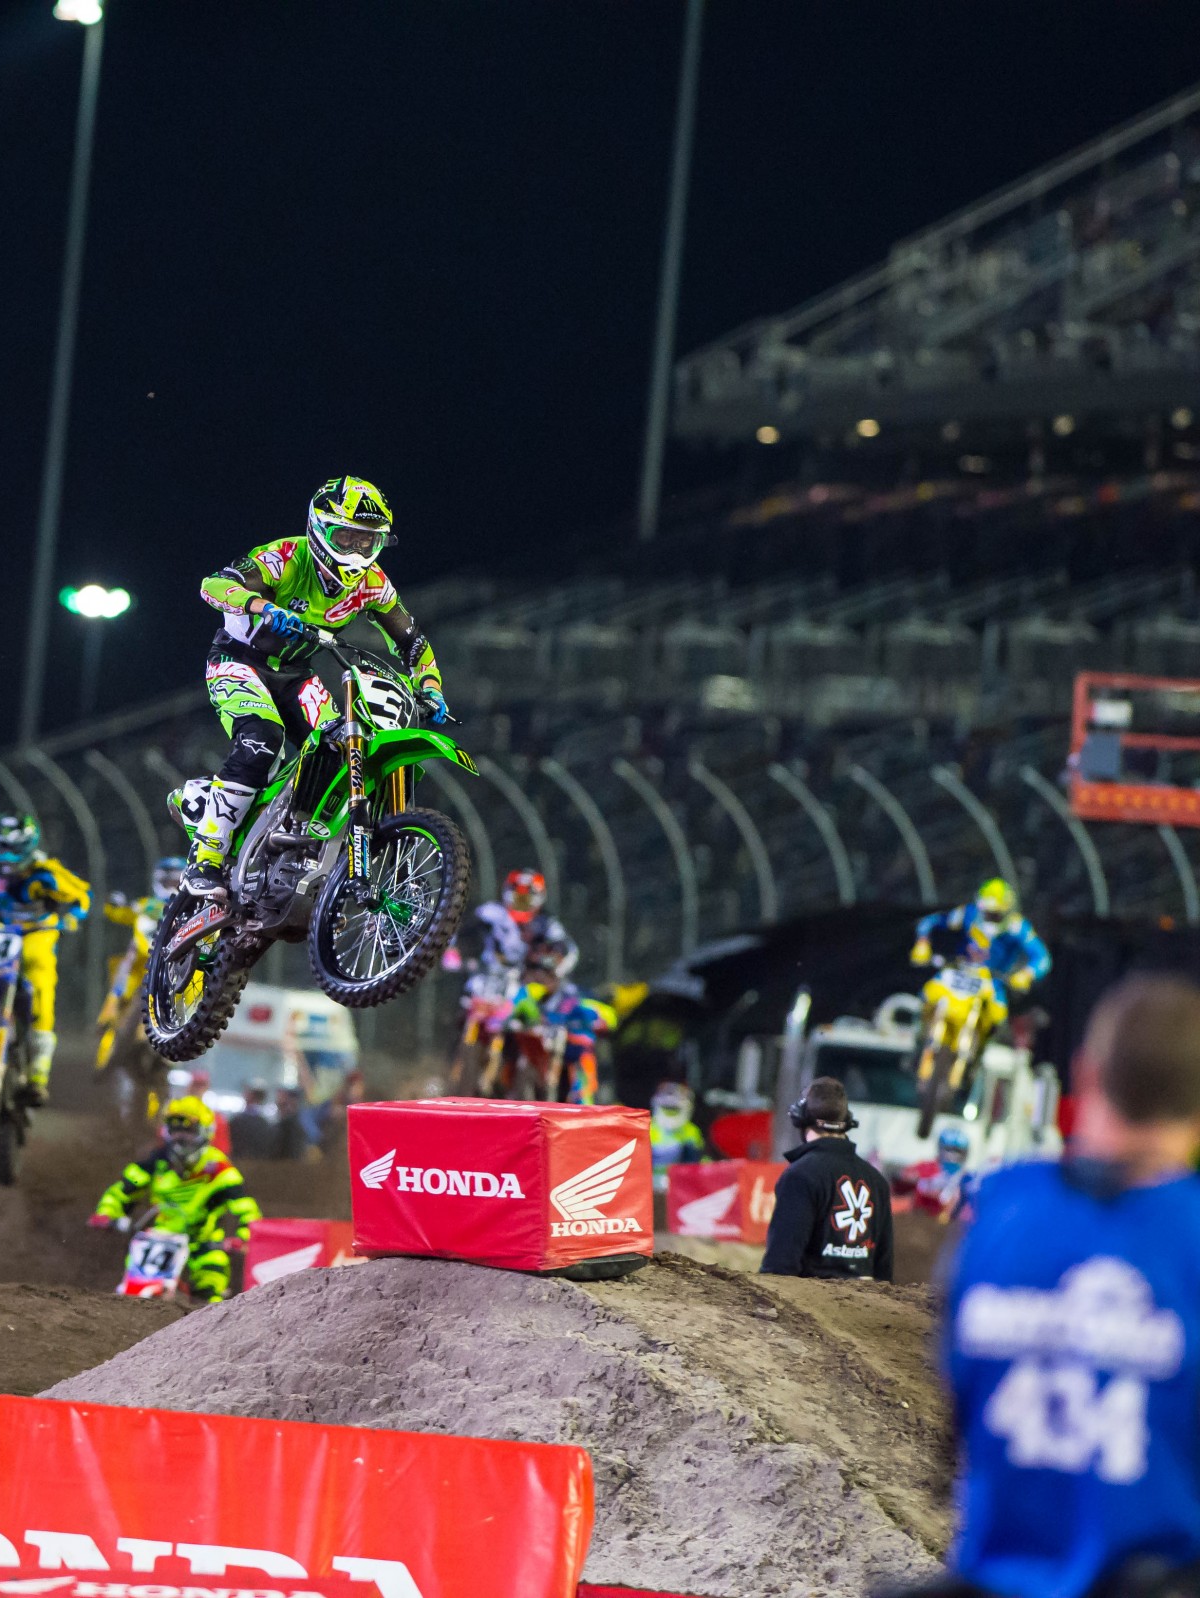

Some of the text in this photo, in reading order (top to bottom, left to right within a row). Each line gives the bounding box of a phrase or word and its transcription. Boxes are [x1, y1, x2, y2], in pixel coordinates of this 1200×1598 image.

[350, 748, 364, 789] KYB
[354, 825, 363, 877] DUNLOP
[396, 1166, 526, 1199] HONDA
[551, 1217, 643, 1238] HONDA
